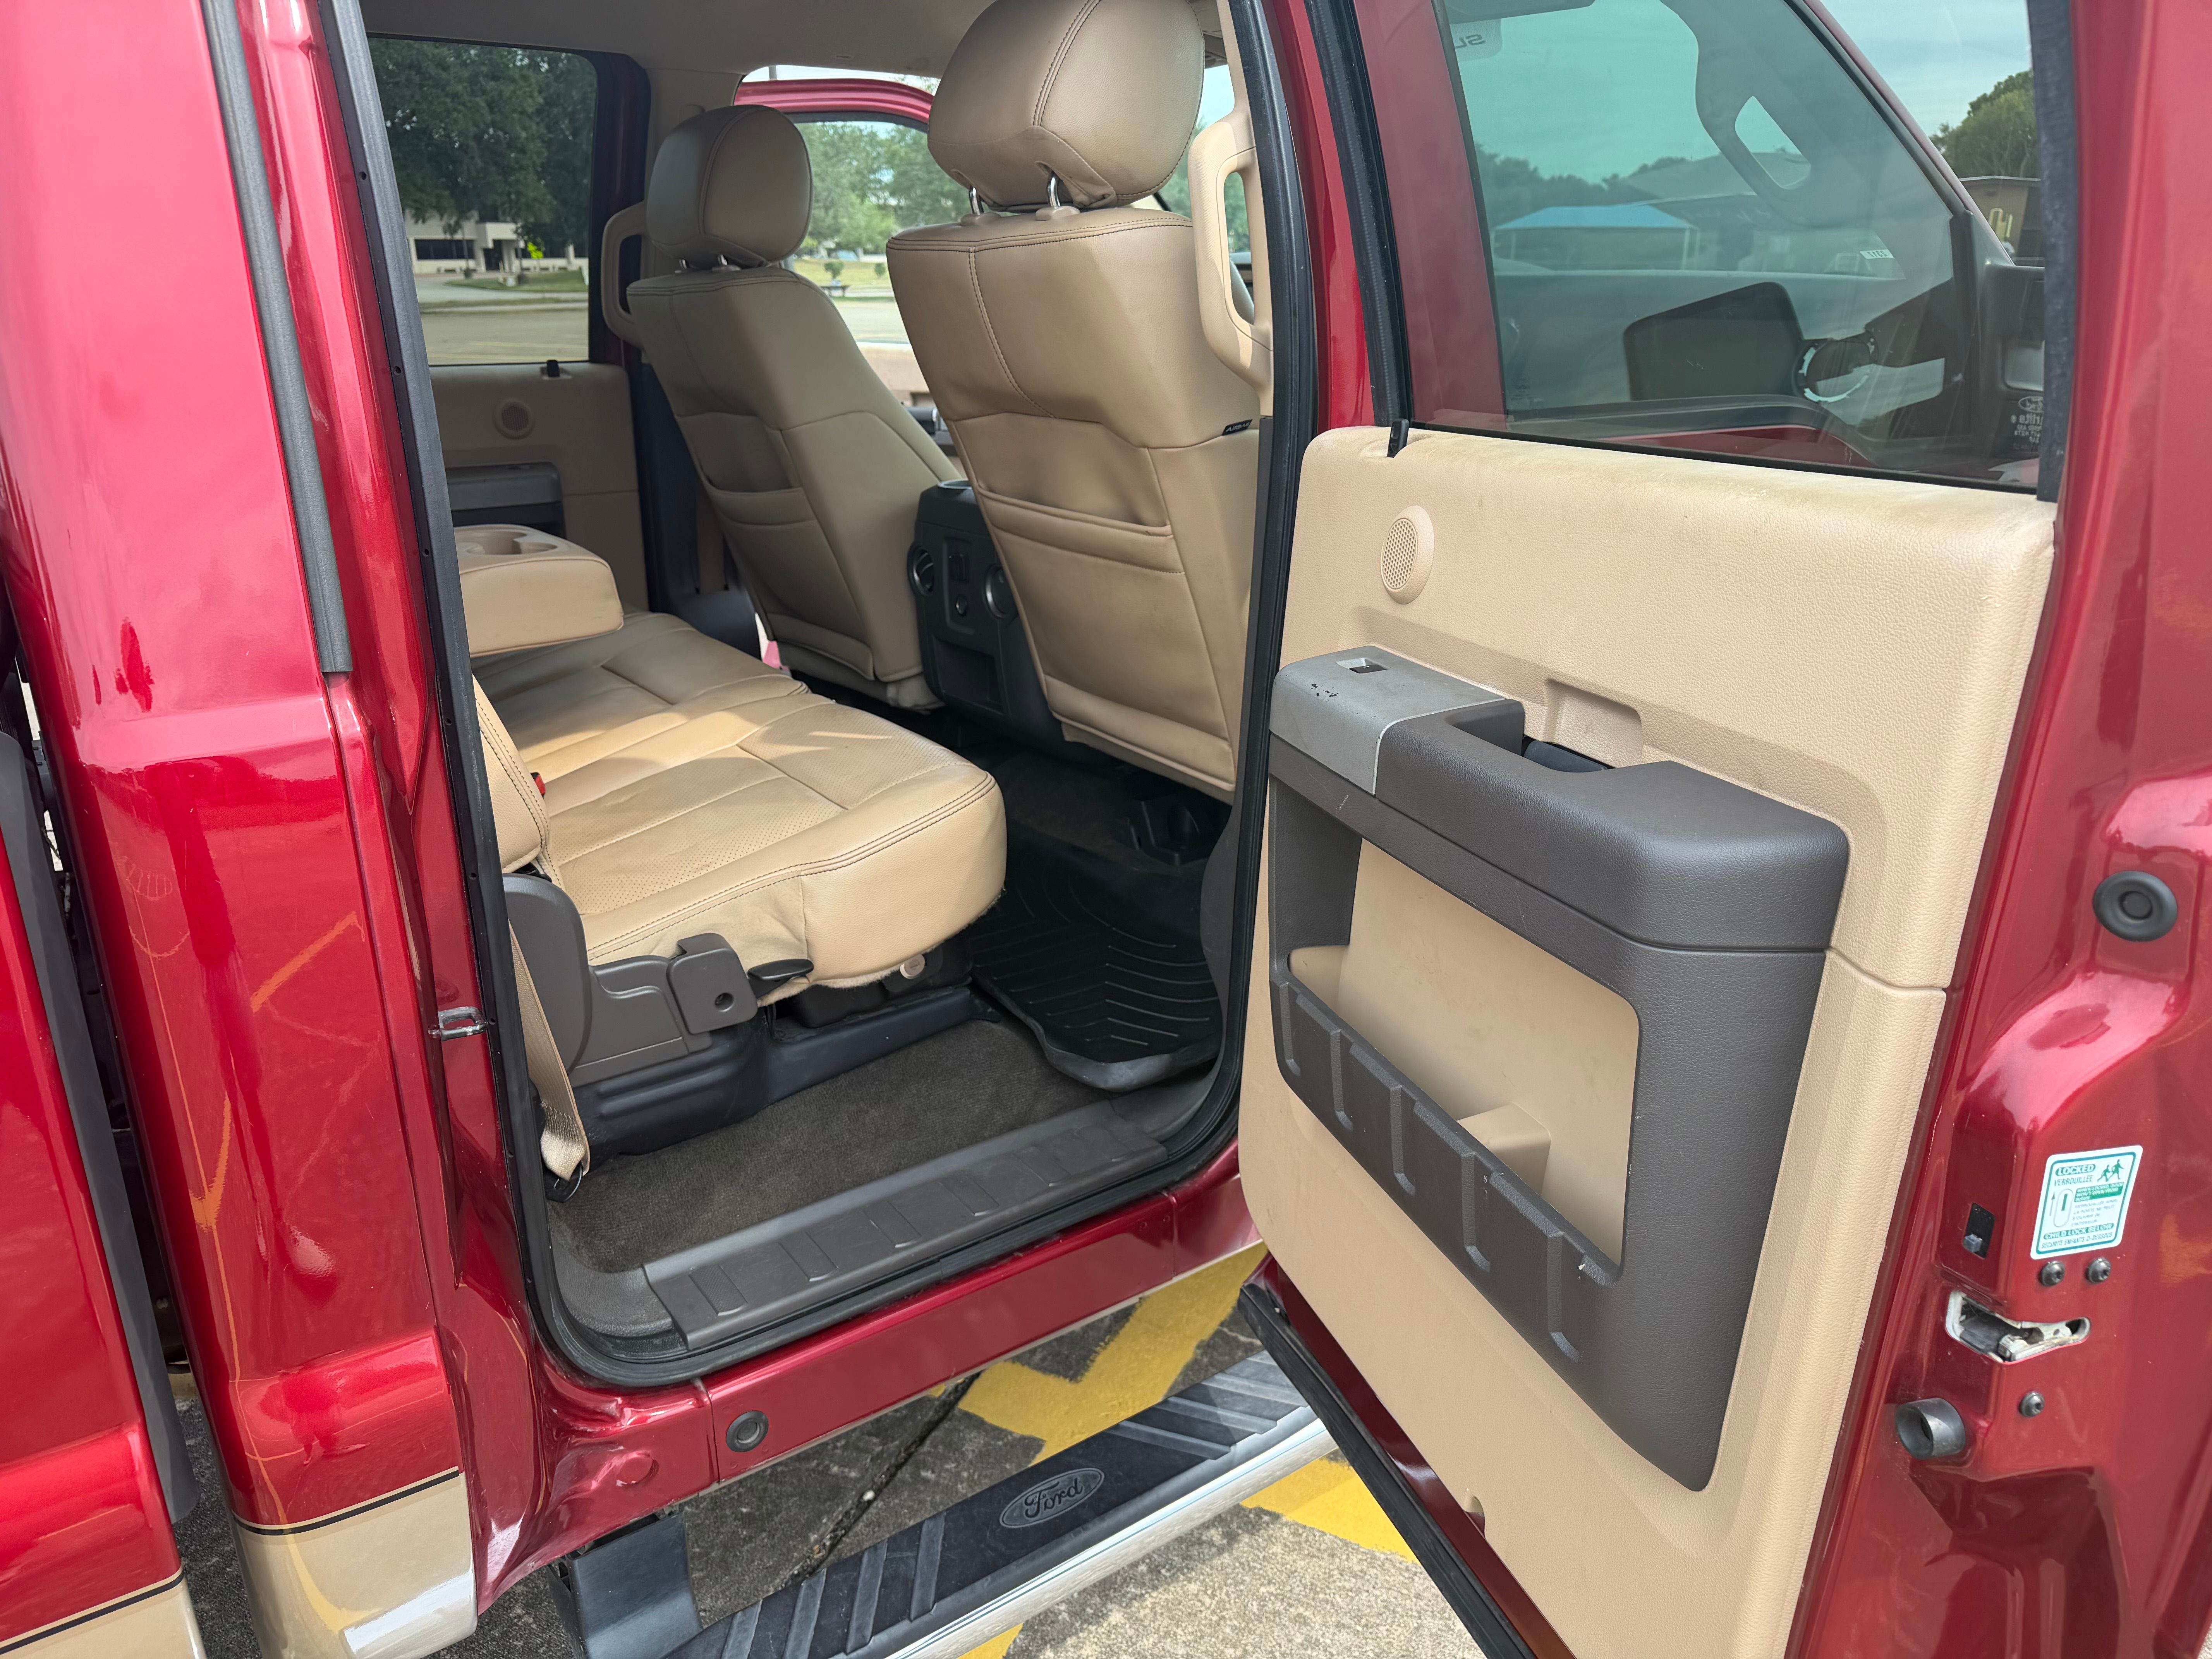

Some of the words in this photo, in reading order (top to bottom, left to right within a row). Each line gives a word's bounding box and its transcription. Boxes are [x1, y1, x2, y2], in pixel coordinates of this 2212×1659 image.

[2057, 1164, 2094, 1176] LOCKED
[2045, 1230, 2067, 1239] CHILD
[2068, 1228, 2087, 1236] LOCK
[2089, 1223, 2113, 1233] BELOW
[1024, 1477, 1083, 1518] Ford
